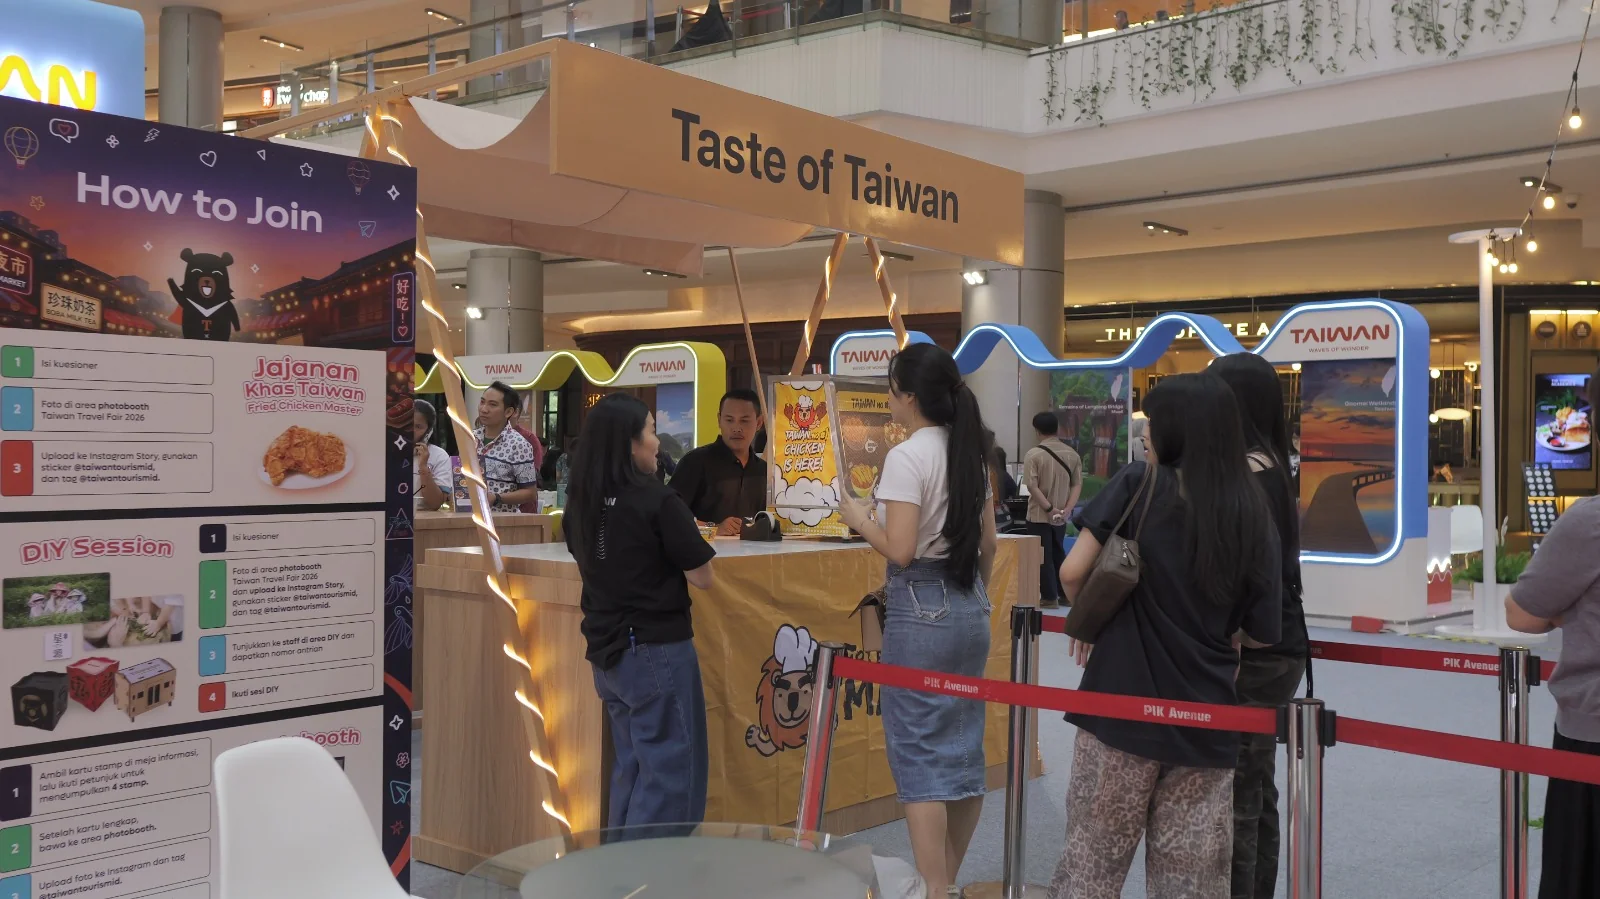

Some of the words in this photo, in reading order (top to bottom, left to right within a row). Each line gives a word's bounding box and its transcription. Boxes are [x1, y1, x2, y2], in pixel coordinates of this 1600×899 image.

[672, 108, 786, 183] Taste
[797, 148, 834, 194] of
[844, 154, 959, 223] Taiwan
[77, 171, 182, 214] How
[193, 189, 237, 221] to
[247, 197, 322, 232] Join
[47, 291, 96, 316] 珍珠奶茶
[46, 308, 65, 317] BOBA
[66, 312, 82, 322] MILK
[84, 317, 96, 325] TEA
[1291, 324, 1390, 344] TAIWAN
[14, 357, 20, 367] 1
[41, 359, 52, 368] Isi
[53, 359, 98, 370] kuesioner
[253, 355, 359, 382] Jajanan
[485, 363, 522, 375] TAIWAN
[639, 360, 686, 372] TAIWAN
[244, 380, 295, 398] Khas
[297, 380, 365, 402] Taiwan
[13, 404, 21, 414] 2
[41, 400, 62, 409] Foto
[64, 400, 73, 409] di
[75, 402, 96, 410] area
[98, 403, 150, 411] photobooth
[247, 401, 277, 413] Fried
[279, 400, 322, 411] Chicken
[324, 402, 361, 415] Master
[41, 411, 75, 420] Taiwan
[77, 412, 105, 420] Travel
[107, 412, 123, 420] Fair
[125, 413, 145, 422] 2026
[784, 442, 826, 456] CHICKEN
[41, 452, 75, 461] Upload
[77, 453, 88, 461] ke
[90, 452, 134, 461] Instagram
[136, 452, 160, 461] Story,
[162, 453, 198, 461] gunakan
[13, 463, 22, 474] 3
[41, 463, 72, 471] sticker
[74, 462, 155, 472] @taiwantourismid,
[784, 458, 792, 473] IS
[794, 455, 824, 473] HERE!
[41, 474, 60, 483] dan
[62, 475, 77, 484] tag
[79, 473, 160, 483] @taiwantourismid.
[211, 534, 216, 543] 1
[232, 532, 242, 541] Isi
[243, 533, 279, 541] kuesioner
[21, 540, 67, 564] DIY
[73, 536, 173, 557] Session
[232, 567, 249, 575] Foto
[251, 566, 259, 574] di
[279, 563, 322, 573] photobooth
[232, 576, 260, 585] Taiwan
[262, 575, 285, 583] Travel
[286, 574, 300, 582] Fair
[301, 573, 318, 581] 2026
[209, 589, 216, 599] 2
[232, 587, 248, 595] dan
[249, 586, 275, 595] upload
[277, 585, 286, 593] ke
[287, 582, 324, 592] Instagram
[325, 581, 345, 589] Story,
[232, 597, 266, 607] gunakan
[267, 594, 291, 603] sticker
[293, 590, 358, 602] @taiwantourismid,
[232, 608, 248, 616] dan
[249, 607, 262, 615] tag
[264, 603, 331, 614] @taiwantourismid.
[232, 640, 271, 651] Tunjukkan
[282, 638, 301, 646] staff
[301, 636, 309, 644] di
[209, 651, 216, 660] 3
[232, 651, 270, 662] dapatkan
[297, 646, 323, 655] antrian
[1443, 657, 1460, 669] PIK
[1463, 658, 1500, 672] Avenue
[231, 688, 249, 698] Ikuti
[249, 687, 265, 695] sesi
[266, 685, 280, 694] DIY
[923, 676, 940, 688] PIK
[943, 680, 979, 694] Avenue
[209, 692, 216, 702] 4
[1143, 704, 1165, 718] PIK
[1168, 708, 1212, 722] Avenue
[40, 771, 67, 780] Ambil
[68, 767, 93, 776] kartu
[94, 762, 123, 773] stamp
[124, 759, 133, 767] di
[134, 757, 157, 766] meja
[157, 749, 199, 762] informasi,
[39, 782, 57, 792] lalu
[58, 779, 78, 788] ikuti
[79, 773, 119, 787] petunjuk
[120, 768, 145, 778] untuk
[12, 787, 19, 798] 1
[39, 786, 111, 803] mengumpulkan
[119, 780, 149, 791] stamp.
[39, 829, 75, 841] Setelah
[76, 824, 101, 834] kartu
[102, 816, 139, 830] lengkap,
[39, 842, 67, 852] bawa
[68, 838, 79, 846] ke
[80, 835, 102, 844] area
[103, 824, 157, 841] photobooth.
[11, 843, 19, 854] 2
[38, 878, 73, 890] Upload
[74, 872, 94, 883] foto
[94, 869, 106, 878] ke
[107, 860, 151, 876] Instagram
[152, 857, 169, 866] dan
[171, 853, 186, 863] tag
